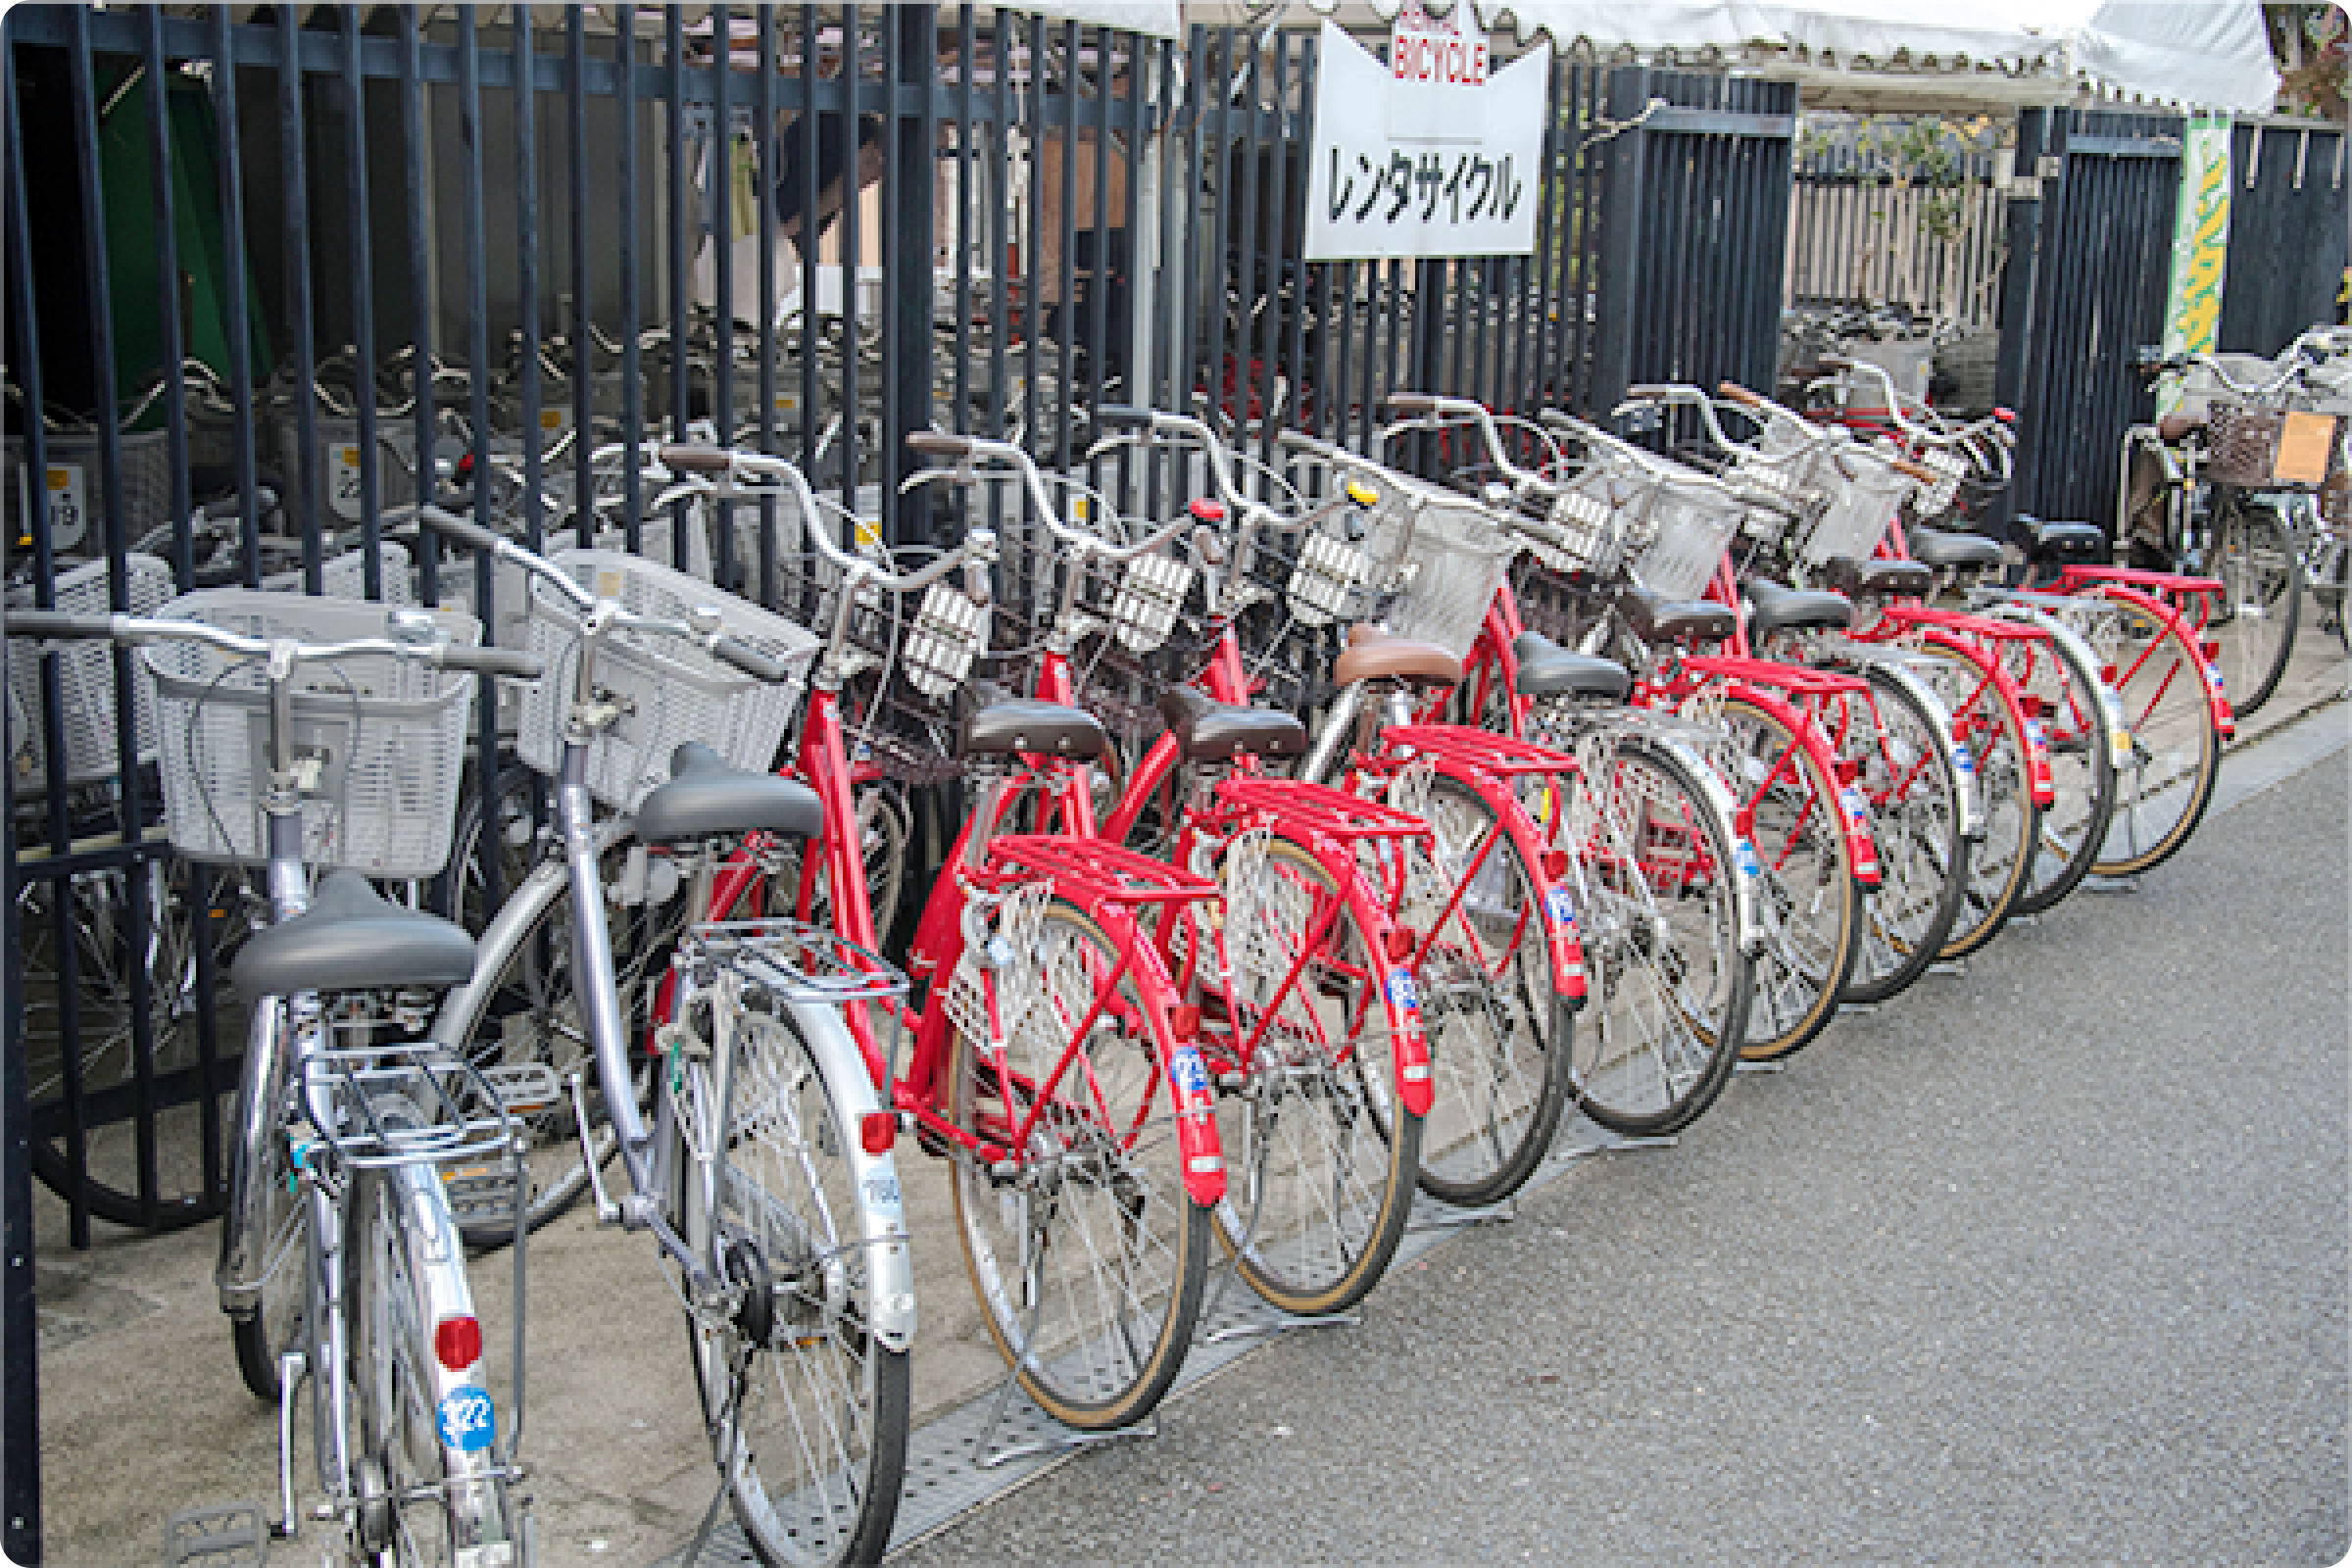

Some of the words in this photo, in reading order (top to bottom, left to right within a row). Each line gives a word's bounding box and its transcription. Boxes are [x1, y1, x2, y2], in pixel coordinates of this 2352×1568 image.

[1395, 34, 1485, 86] BICYCLE
[1328, 148, 1521, 223] レンタサイクル
